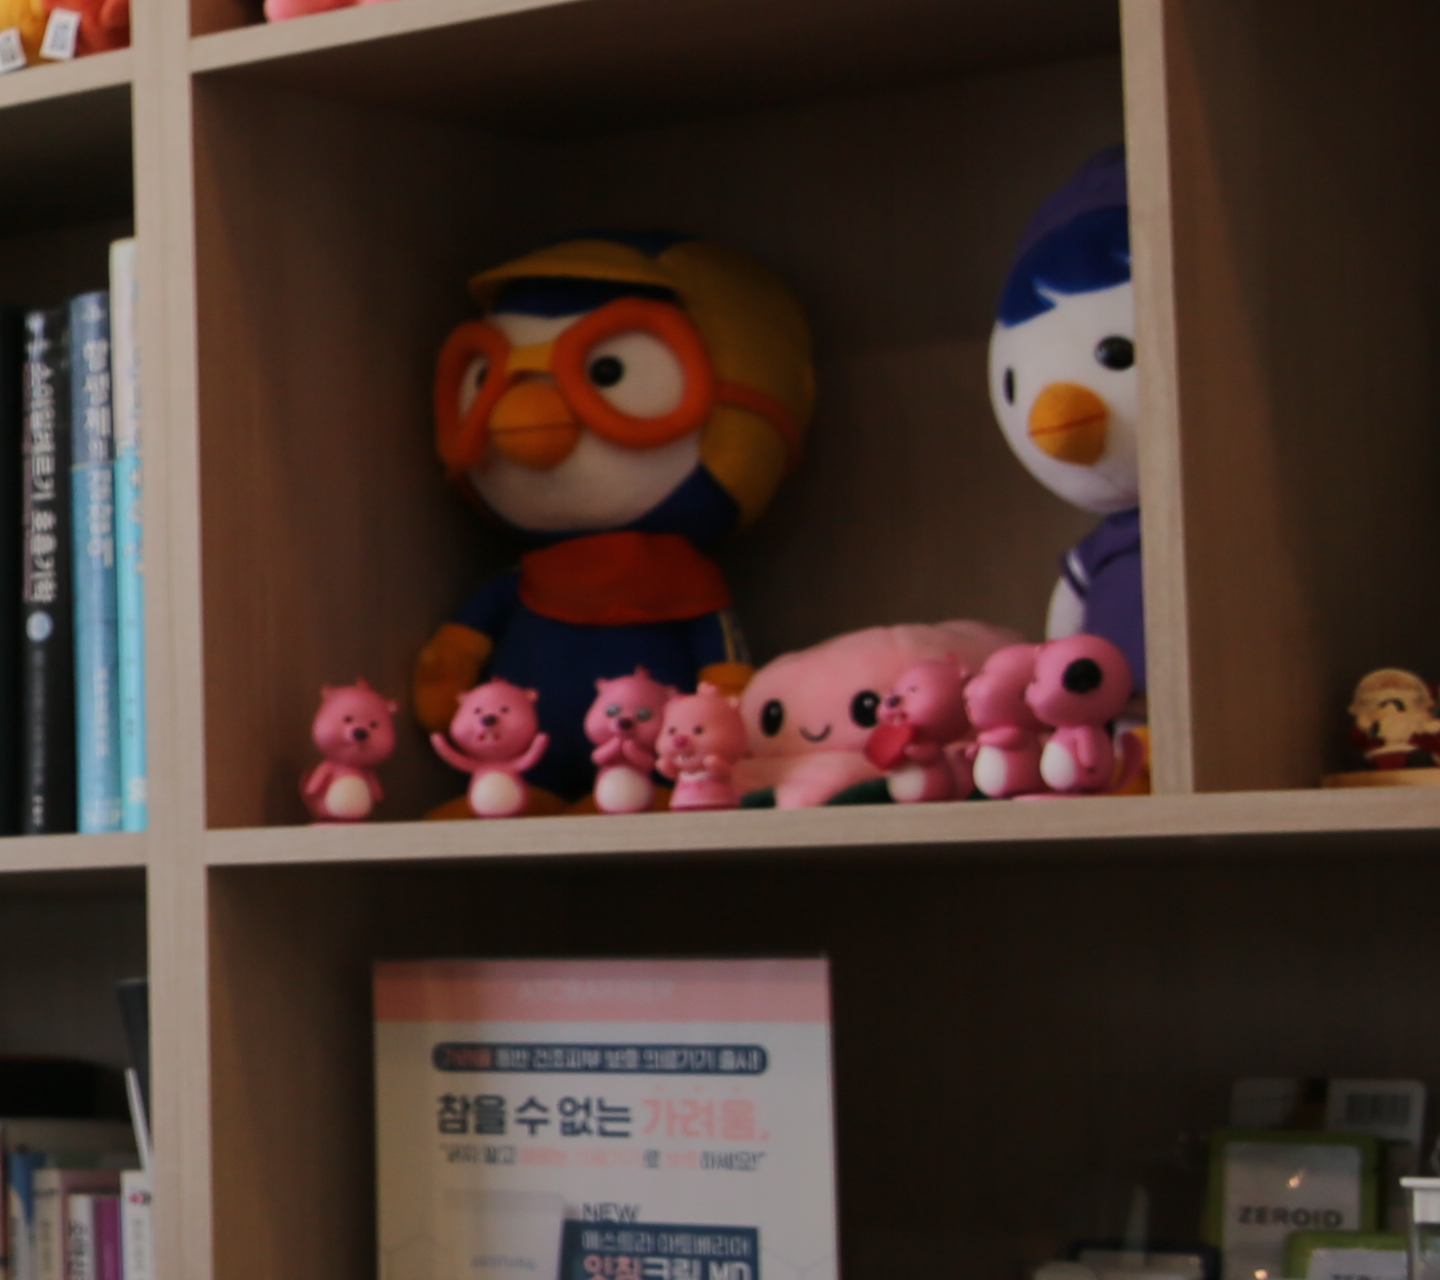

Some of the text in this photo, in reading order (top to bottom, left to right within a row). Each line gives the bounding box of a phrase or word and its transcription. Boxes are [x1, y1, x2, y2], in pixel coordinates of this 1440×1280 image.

[558, 1096, 631, 1139] 없는
[583, 1204, 640, 1223] NEW
[1238, 1206, 1343, 1227] ZEROID
